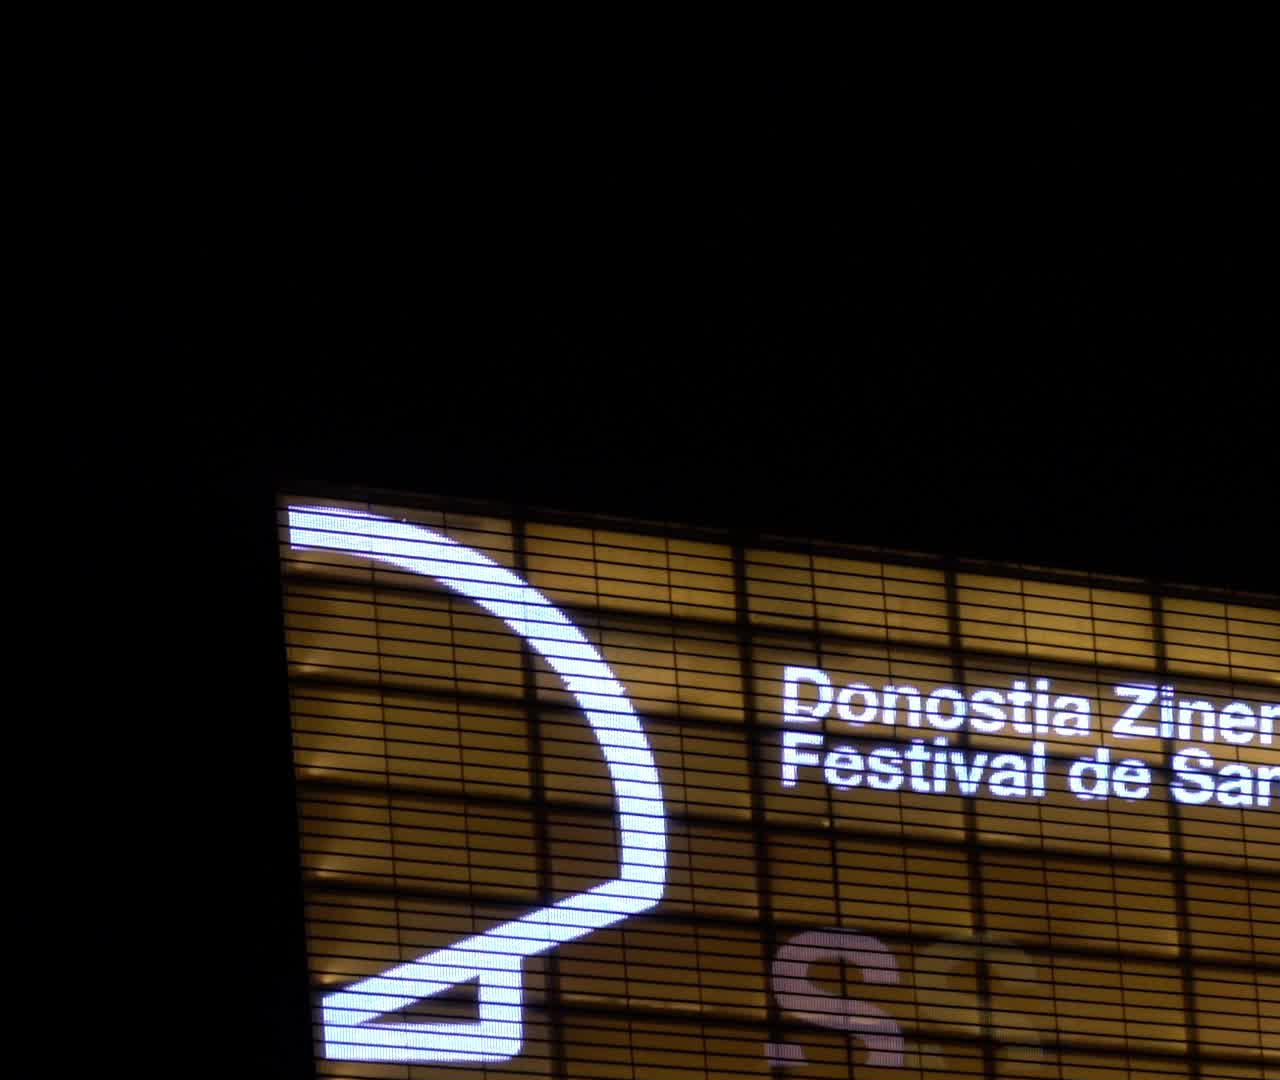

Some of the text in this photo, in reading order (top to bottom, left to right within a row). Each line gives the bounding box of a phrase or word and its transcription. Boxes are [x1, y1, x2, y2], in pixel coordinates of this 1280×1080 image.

[783, 665, 1091, 736] Donostia
[781, 731, 1047, 797] Festival
[1068, 747, 1151, 801] de
